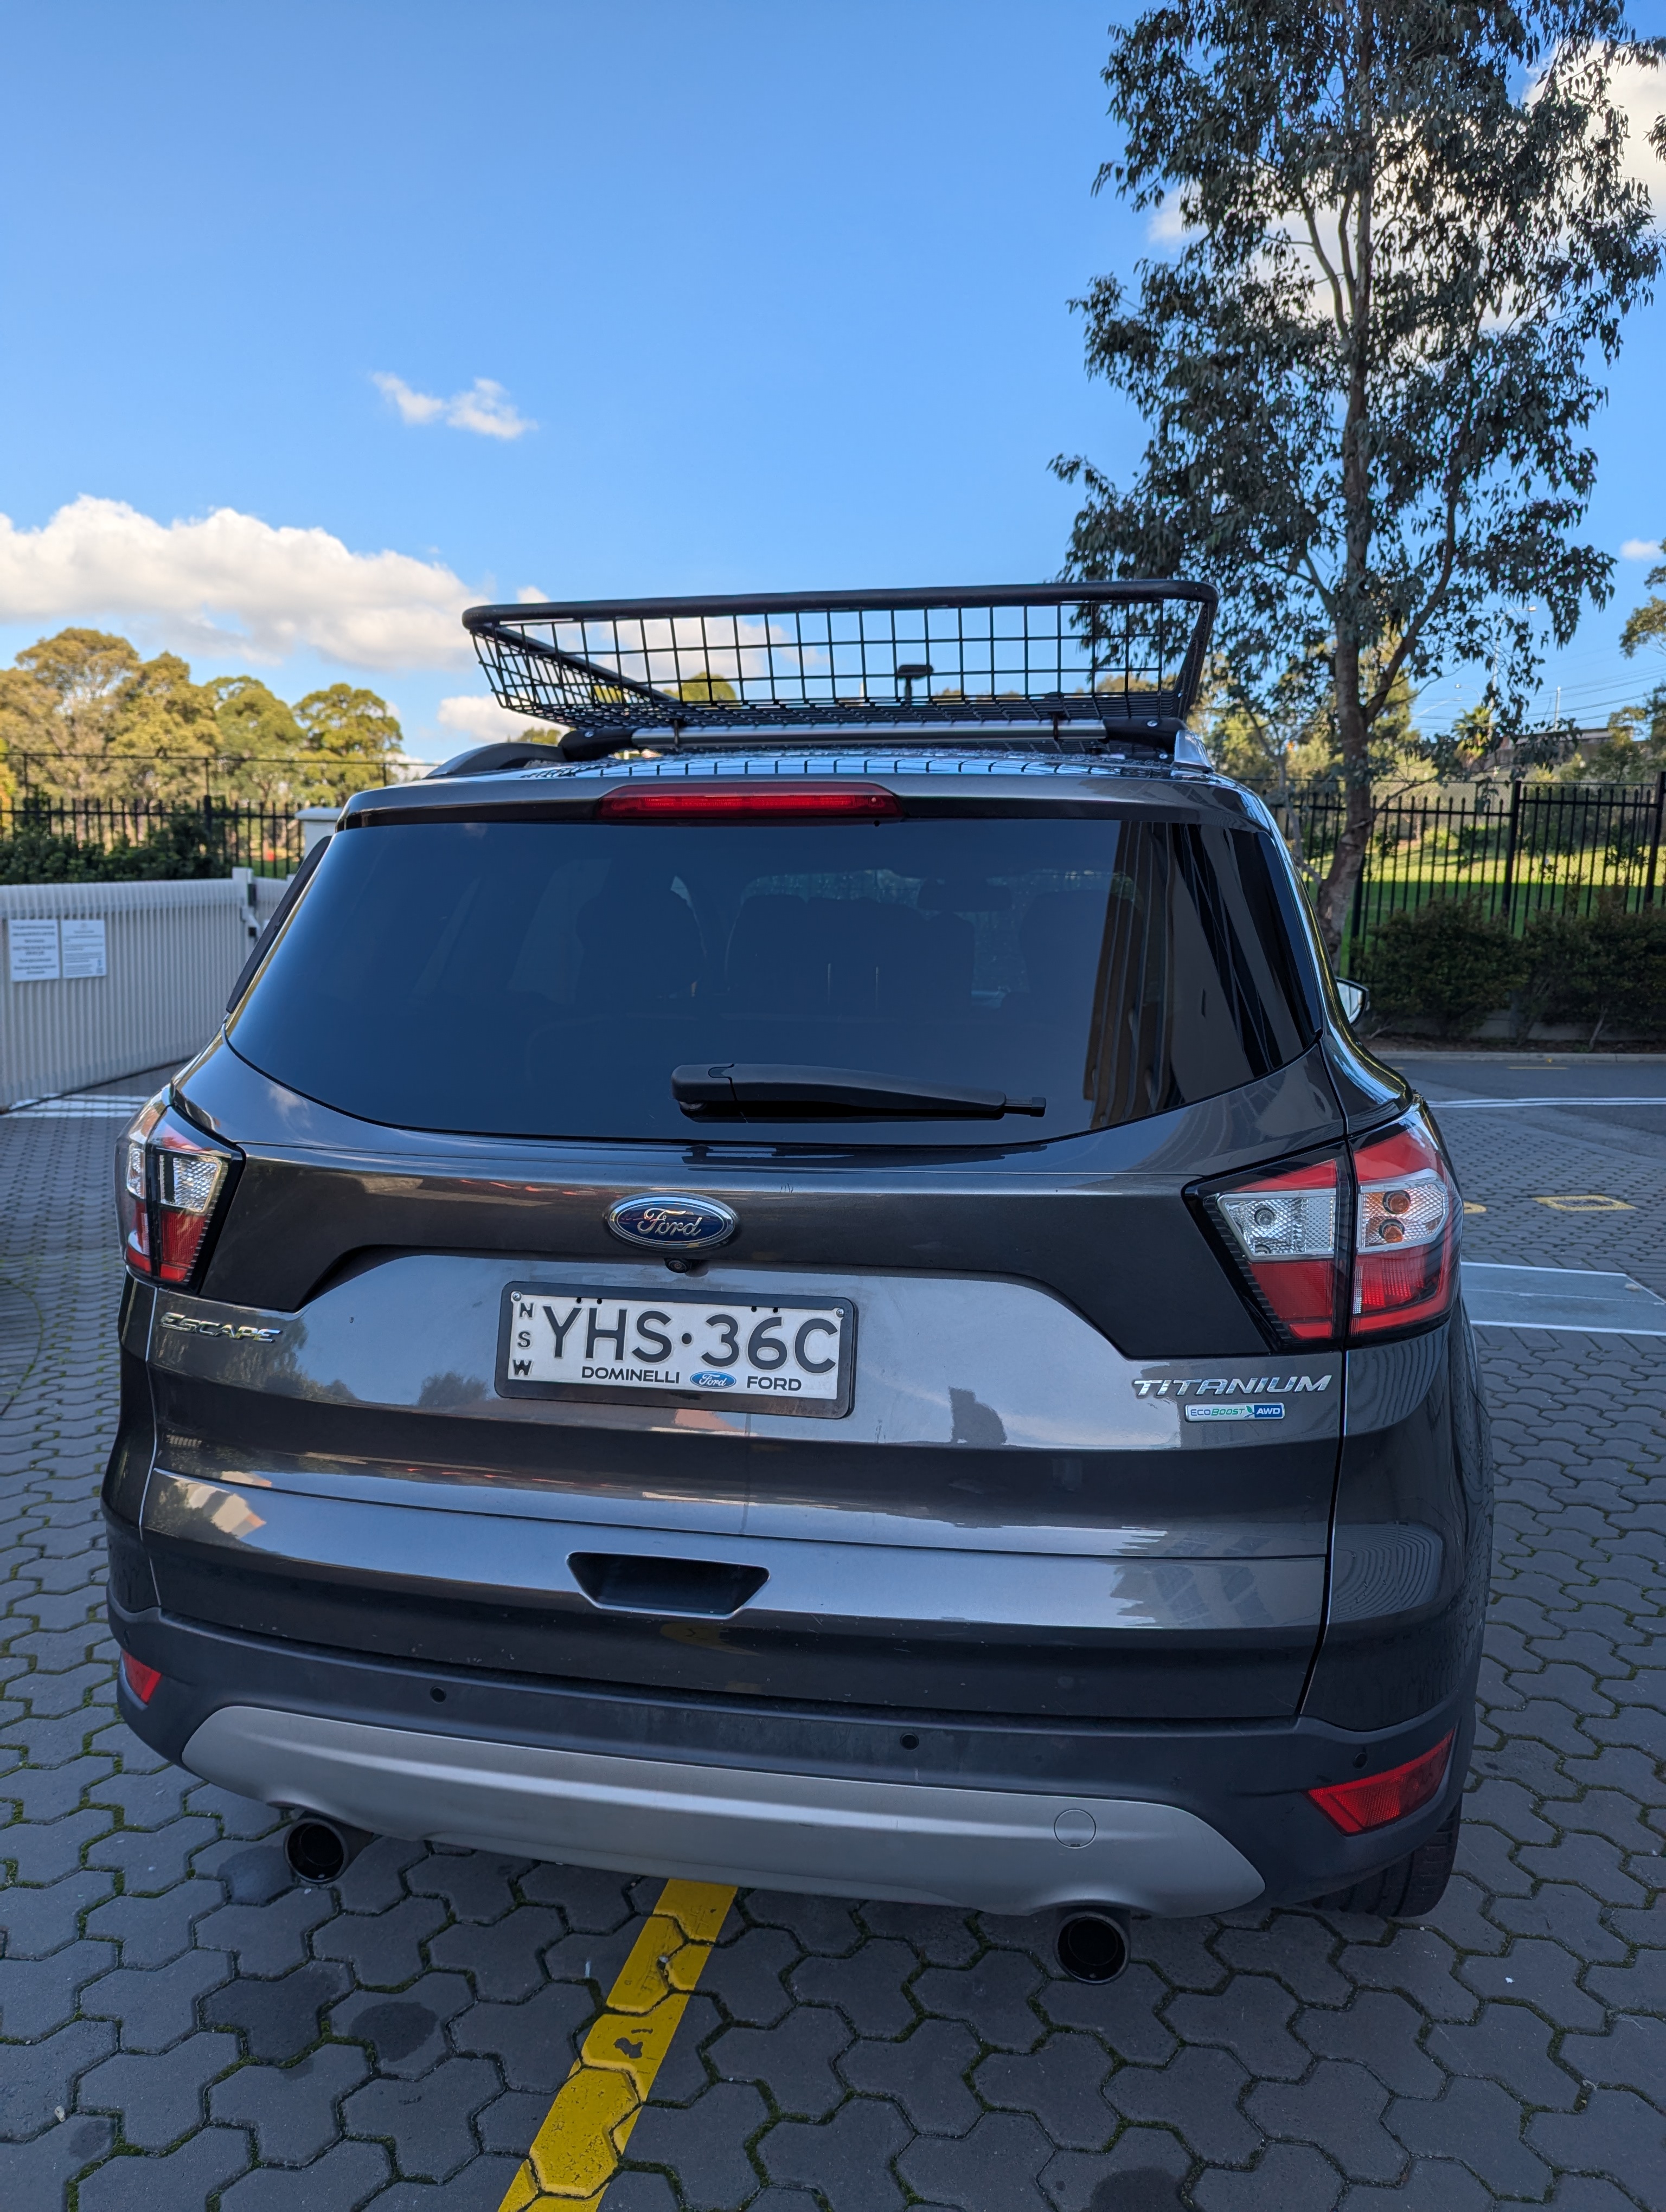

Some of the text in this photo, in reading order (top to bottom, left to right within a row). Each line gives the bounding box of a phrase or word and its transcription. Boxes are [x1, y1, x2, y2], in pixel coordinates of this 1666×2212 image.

[637, 1207, 703, 1237] Ford
[161, 1312, 283, 1342] ESCAPE
[581, 1366, 802, 1391] DOMINELLI Ford FORD
[1133, 1375, 1332, 1396] TITANIUM
[1256, 1407, 1280, 1415] AWD
